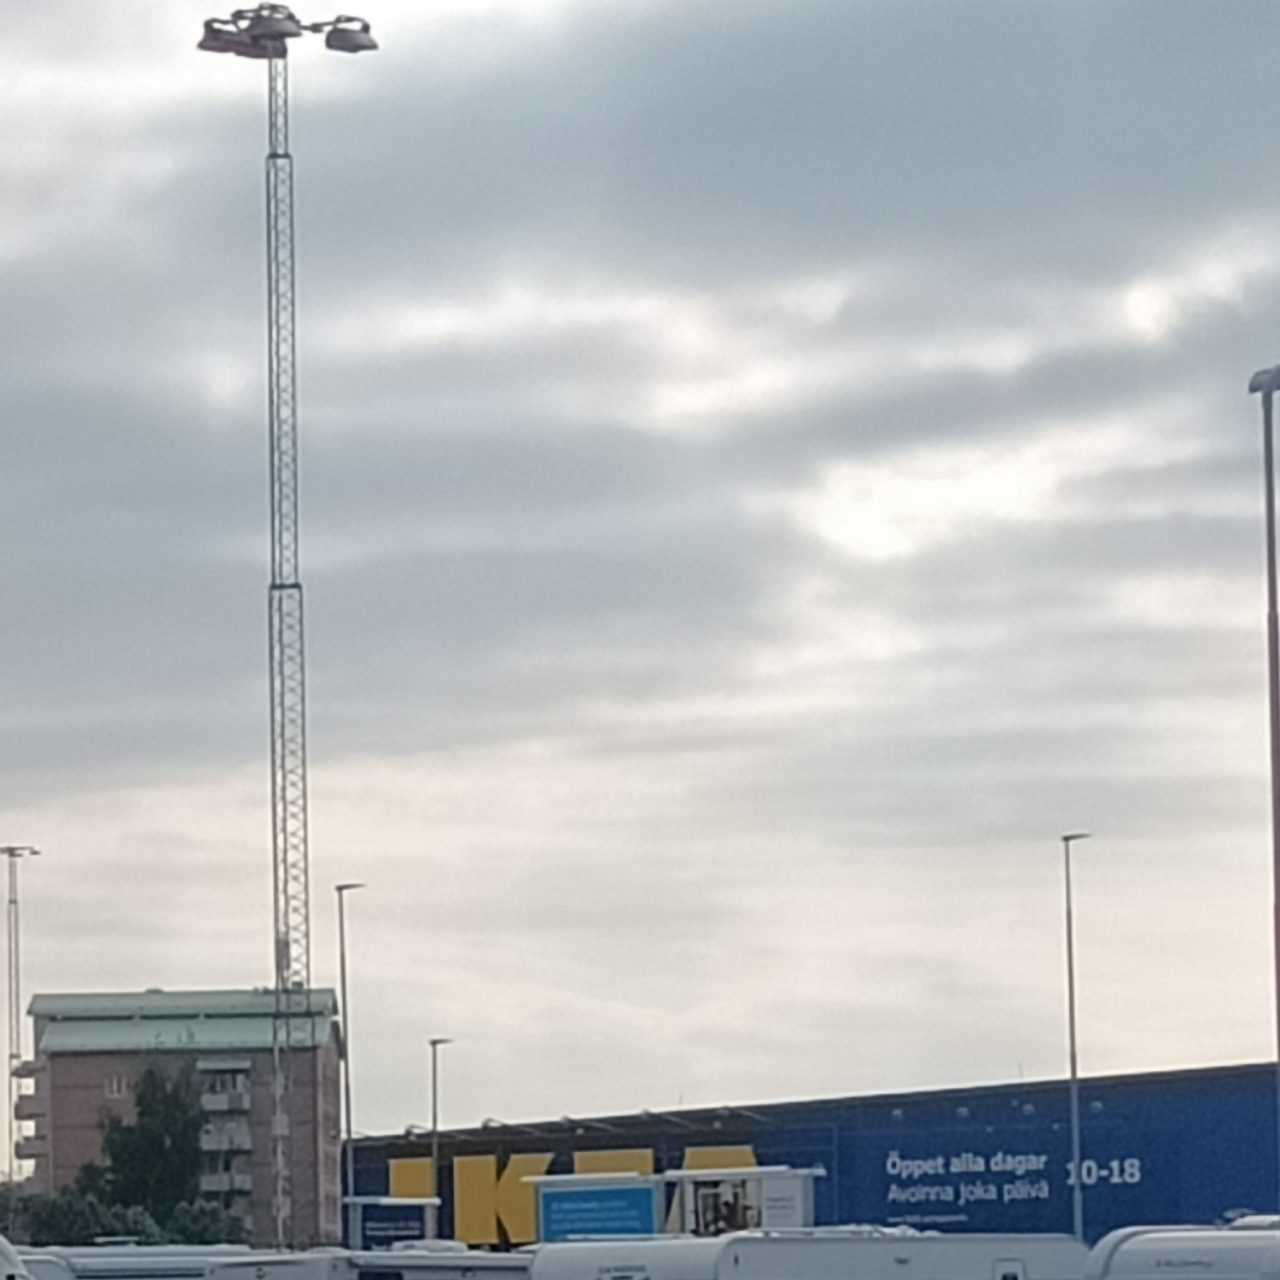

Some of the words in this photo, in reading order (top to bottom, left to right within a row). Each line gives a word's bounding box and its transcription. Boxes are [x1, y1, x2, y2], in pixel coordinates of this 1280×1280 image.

[886, 1150, 945, 1179] Öppet
[950, 1152, 985, 1173] alla
[989, 1151, 1047, 1176] dagar
[1066, 1158, 1141, 1185] 10-18
[887, 1183, 955, 1202] Avoinna
